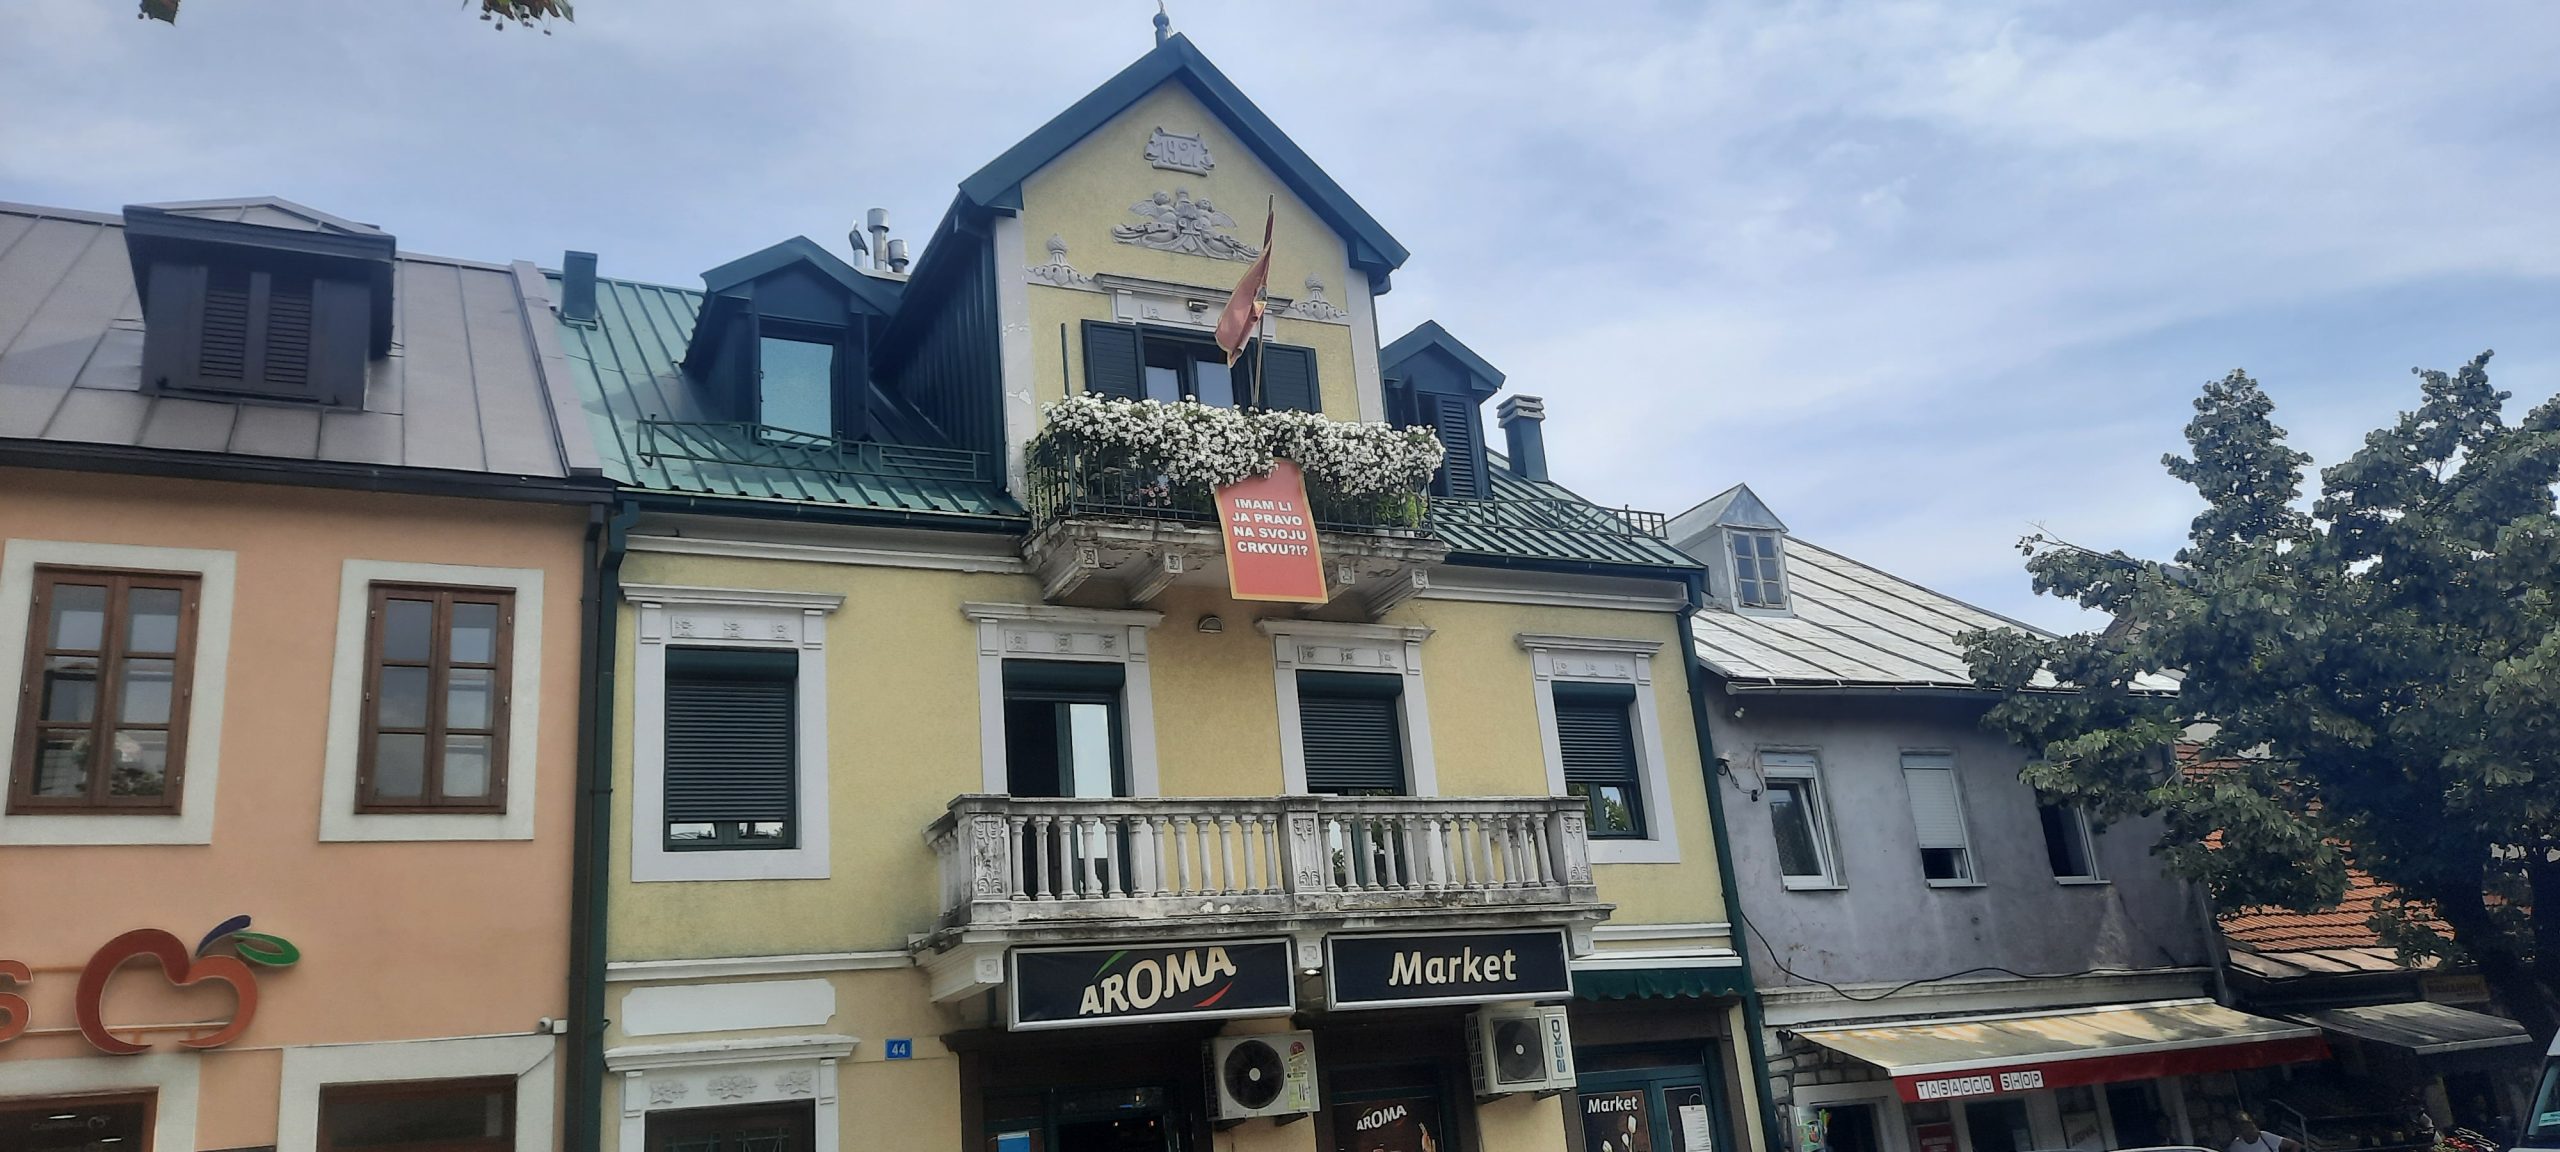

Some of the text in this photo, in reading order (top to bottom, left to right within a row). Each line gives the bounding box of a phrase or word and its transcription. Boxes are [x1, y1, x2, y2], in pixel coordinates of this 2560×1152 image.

[1157, 140, 1198, 168] 1927
[1234, 498, 1292, 512] IMAM LI
[1232, 512, 1303, 526] JA PRAVO
[1233, 526, 1307, 541] NA SVOJU
[1237, 541, 1309, 556] CRKVU?!?
[1388, 946, 1518, 987] Market
[1079, 946, 1237, 1016] AROMA
[891, 1042, 907, 1057] 44
[1917, 1073, 2041, 1098] TABACCO SHOP
[1587, 1095, 1638, 1114] Market
[1356, 1105, 1407, 1131] AROMA
